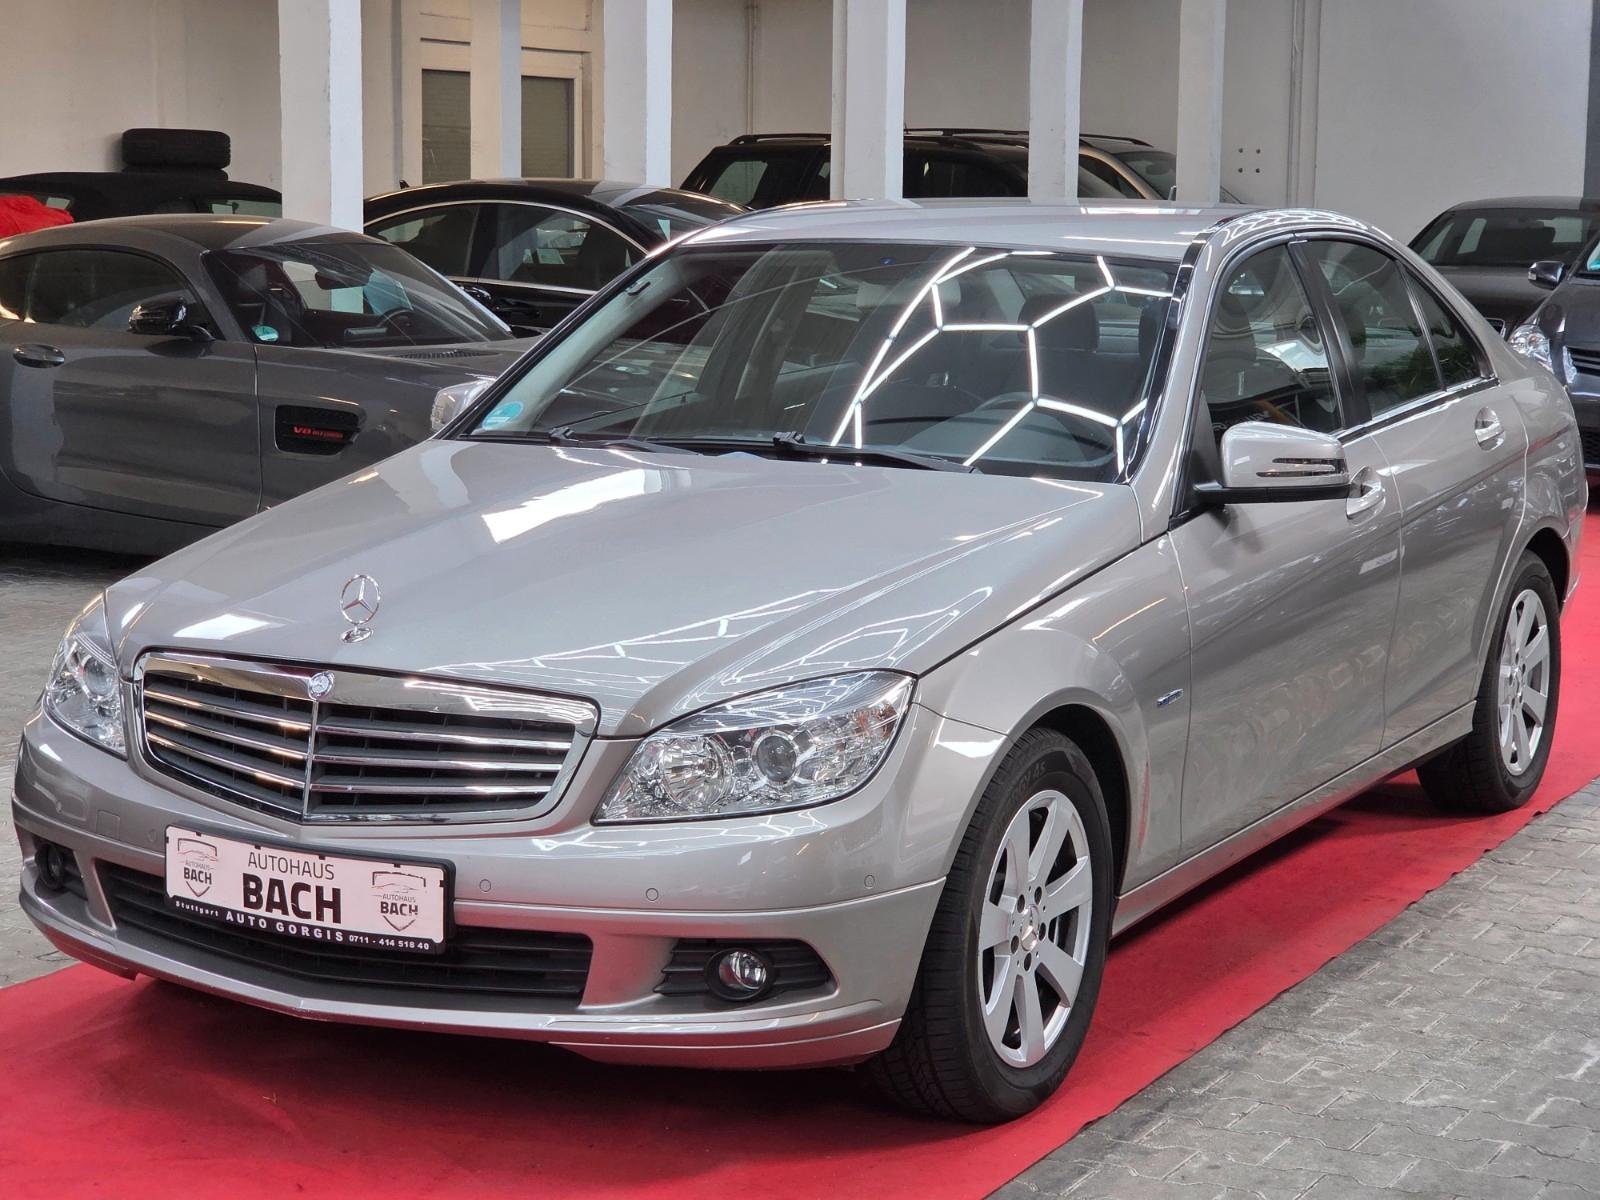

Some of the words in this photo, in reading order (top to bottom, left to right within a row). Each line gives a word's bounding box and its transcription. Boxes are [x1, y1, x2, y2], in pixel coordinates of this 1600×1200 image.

[185, 860, 211, 870] AUTOHAUS
[248, 852, 335, 880] AUTOHAUS
[184, 867, 212, 885] BACH
[242, 873, 341, 924] BACH
[382, 893, 416, 903] AUTOHAUS
[380, 901, 418, 916] BACH
[175, 901, 219, 917] Stuttgart
[226, 911, 267, 929] AUTO
[275, 922, 344, 942] GORGIS
[348, 935, 369, 944] 0711
[379, 938, 395, 947] 414
[398, 940, 415, 949] 518
[417, 942, 430, 950] 40
